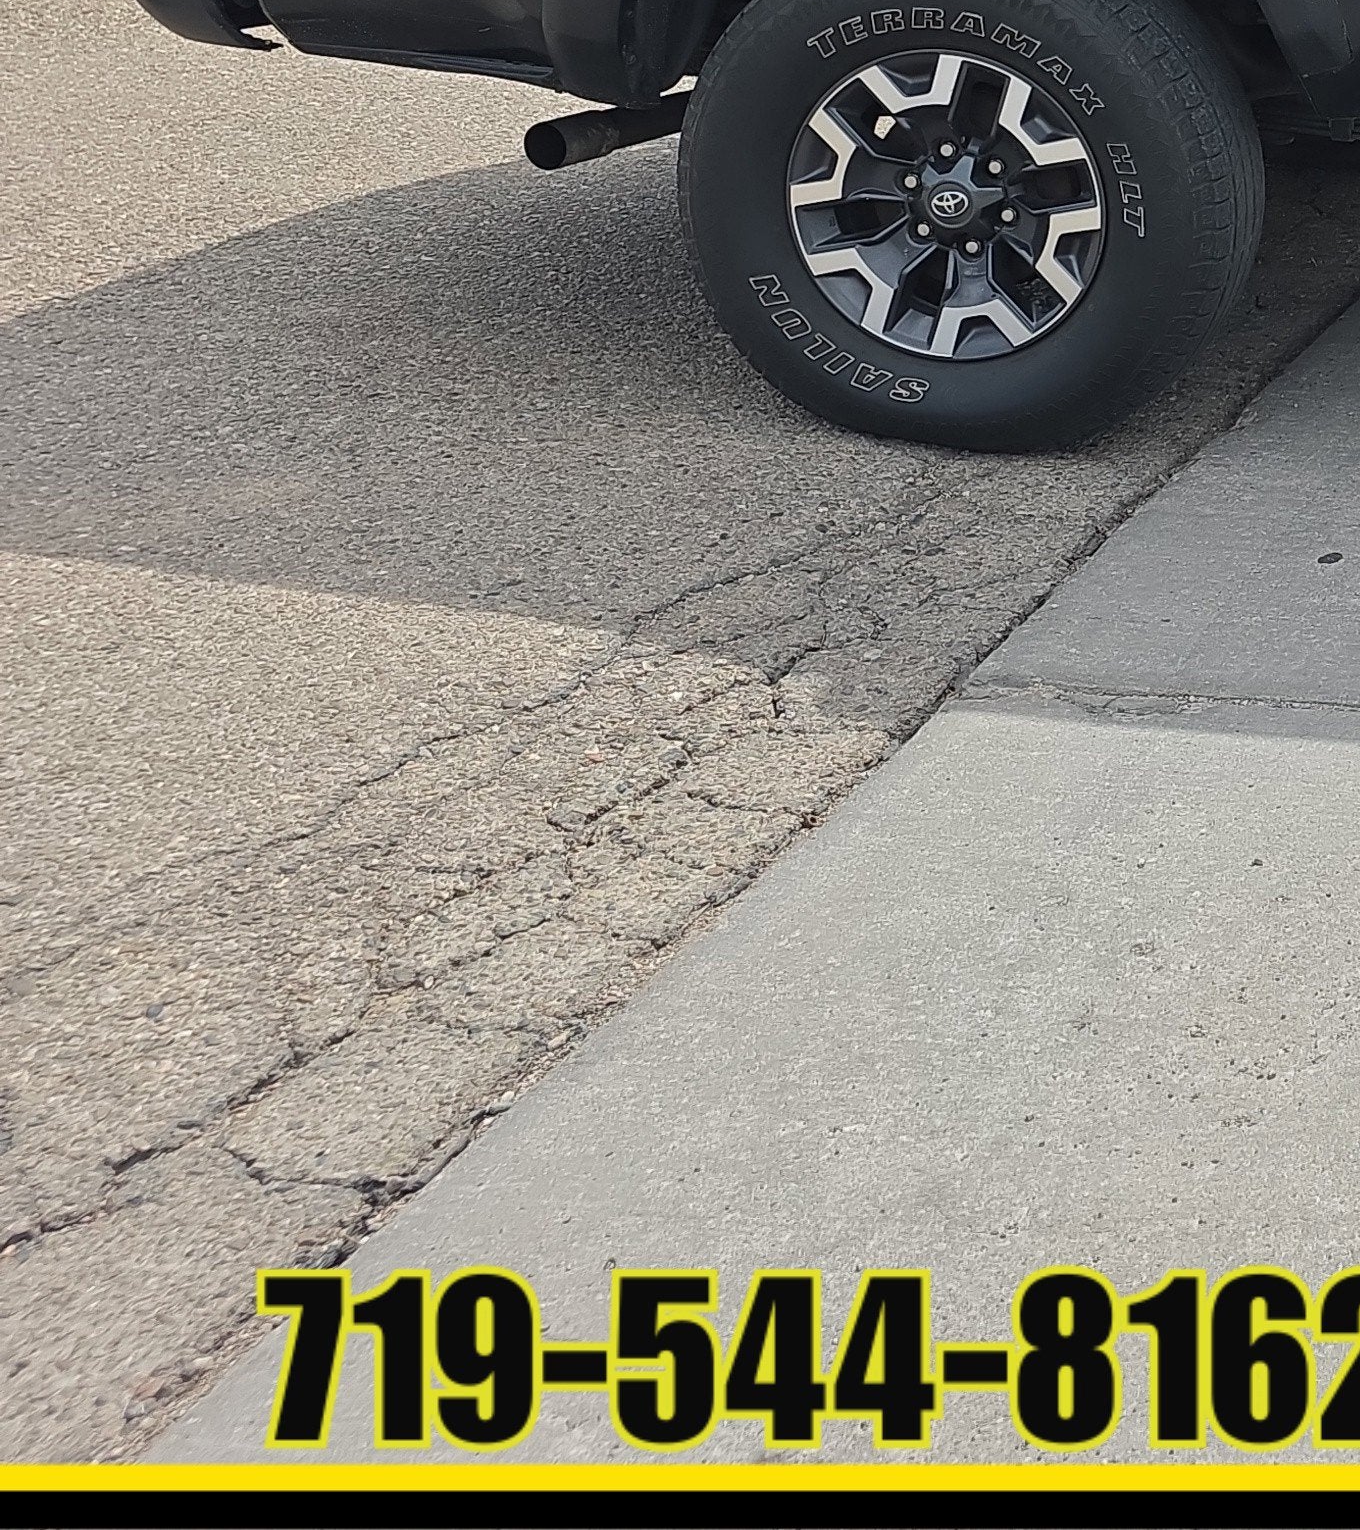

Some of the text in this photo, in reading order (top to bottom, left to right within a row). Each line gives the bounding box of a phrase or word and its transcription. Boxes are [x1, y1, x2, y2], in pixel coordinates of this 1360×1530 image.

[806, 6, 1146, 238] TERRAMAX HLT
[749, 273, 930, 403] SAILUN
